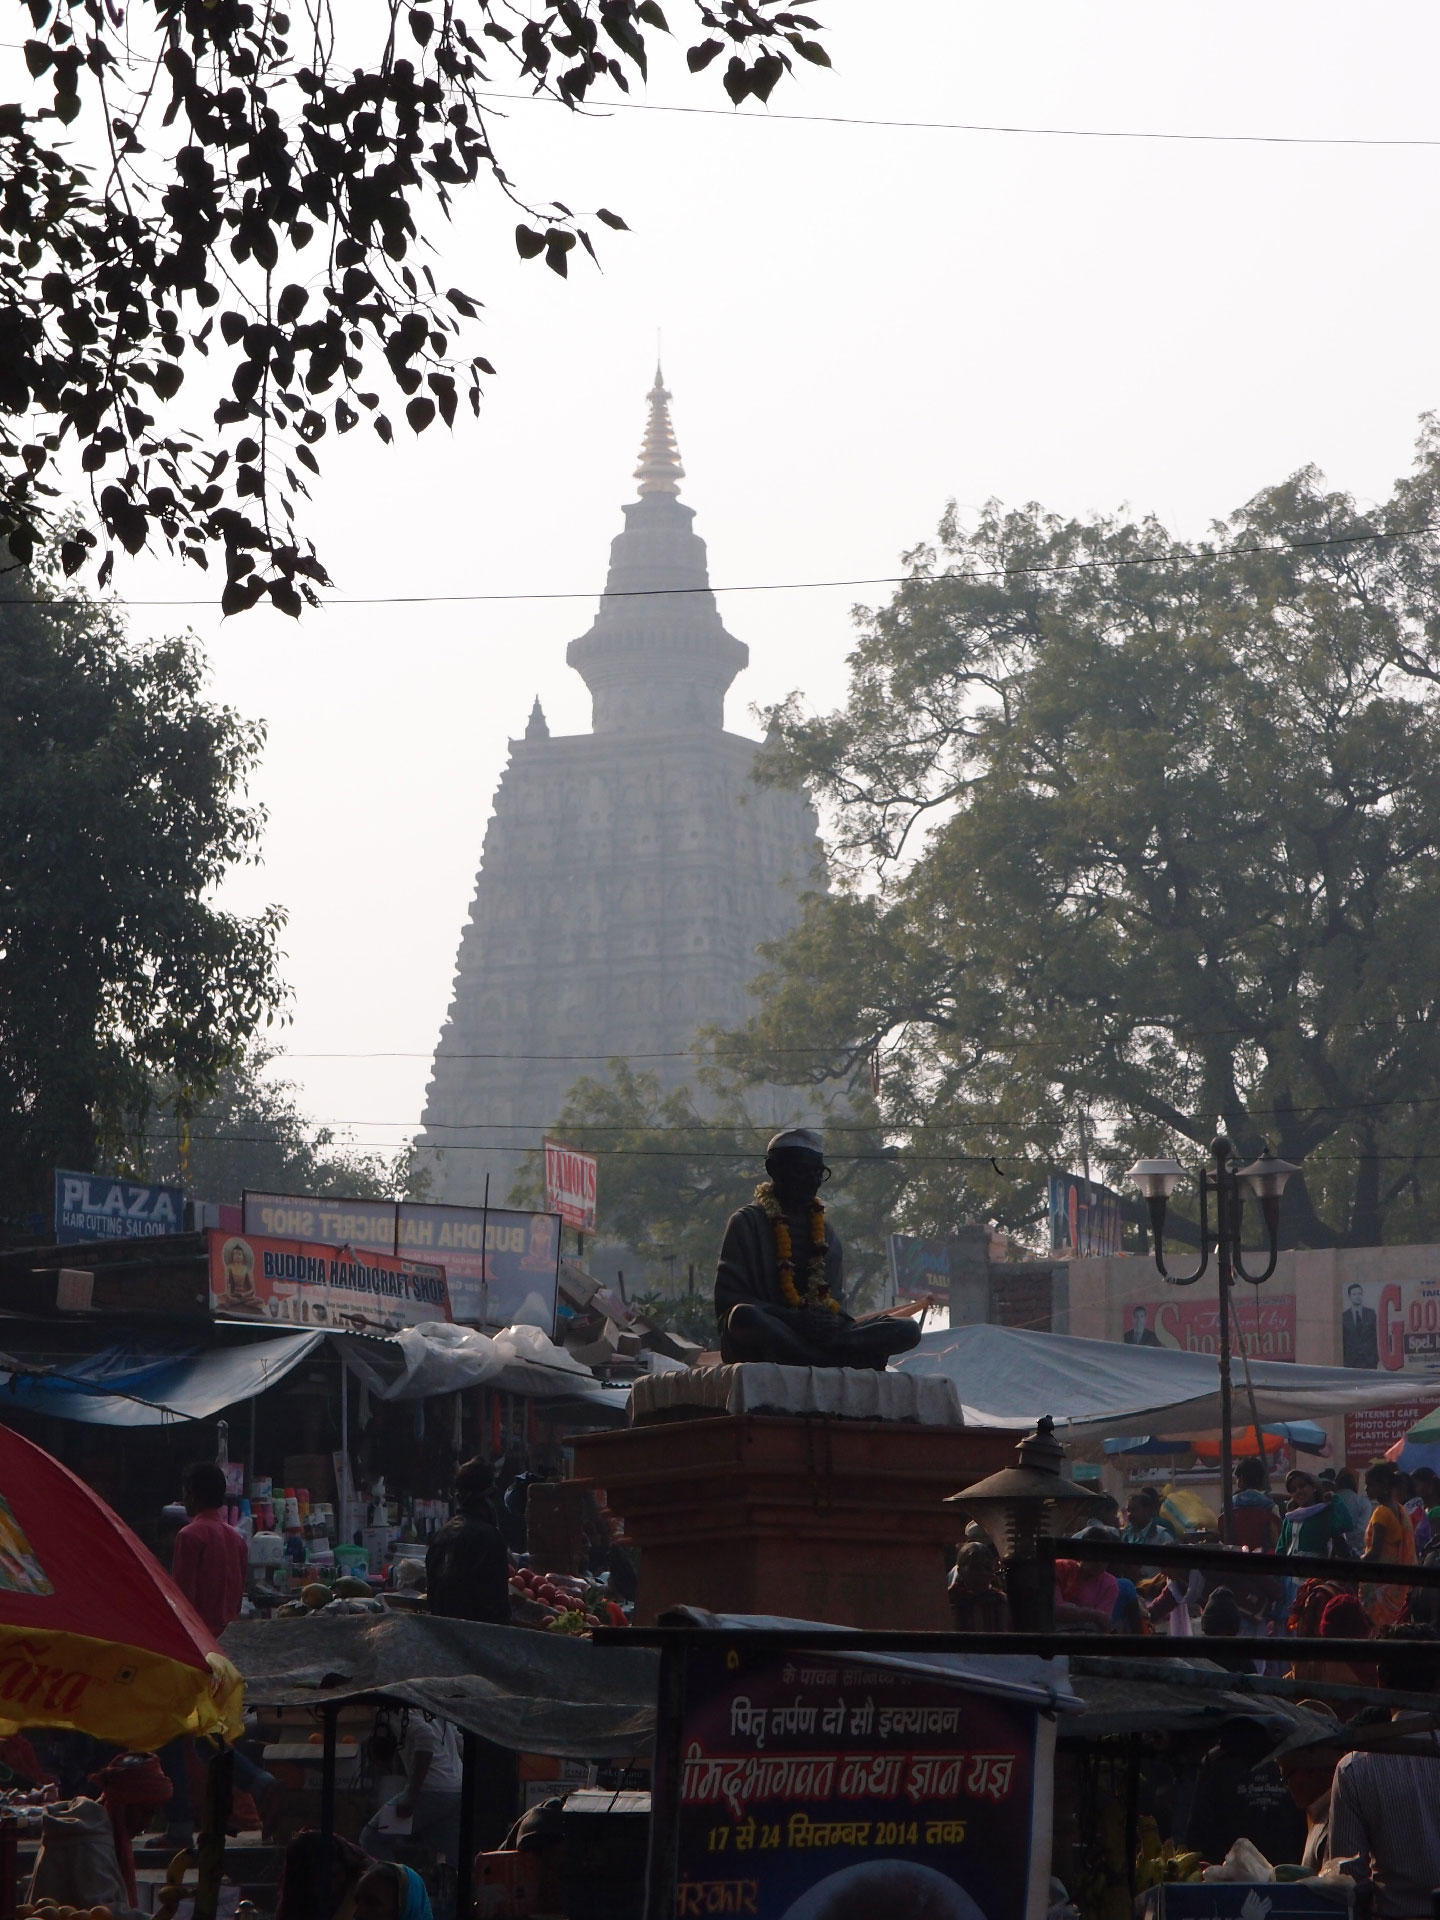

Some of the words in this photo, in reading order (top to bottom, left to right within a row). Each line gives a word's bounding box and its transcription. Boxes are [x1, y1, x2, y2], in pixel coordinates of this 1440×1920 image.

[546, 1147, 596, 1203] FAMOUS
[63, 1178, 177, 1223] PLAZA
[62, 1211, 85, 1229] HAIR
[86, 1214, 122, 1235] CUTTING
[125, 1218, 166, 1238] SALOON
[263, 1251, 327, 1287] BUDDHA
[329, 1259, 411, 1300] HANDICRAFT
[411, 1274, 448, 1305] SHOP
[1354, 1409, 1395, 1419] INTERNET
[1397, 1408, 1419, 1418] CAFE
[1355, 1420, 1384, 1430] PHOTO
[1385, 1419, 1407, 1429] COPY
[1355, 1431, 1389, 1440] PLASTIC
[731, 1696, 766, 1749] पितृ
[771, 1695, 818, 1736] तर्पण
[822, 1696, 847, 1735] दो
[850, 1695, 877, 1736] सौ
[879, 1706, 961, 1739] इक्यावन
[681, 1741, 838, 1817] ीमद्भागवत
[839, 1754, 906, 1797] कथा
[907, 1754, 965, 1801] ज्ञान
[967, 1753, 1017, 1799] यज्ञ
[707, 1826, 730, 1851] 17
[735, 1815, 756, 1850] से
[760, 1824, 780, 1848] 24
[786, 1812, 872, 1849] सितम्बर
[874, 1821, 919, 1846] 2014
[925, 1819, 968, 1845] तक
